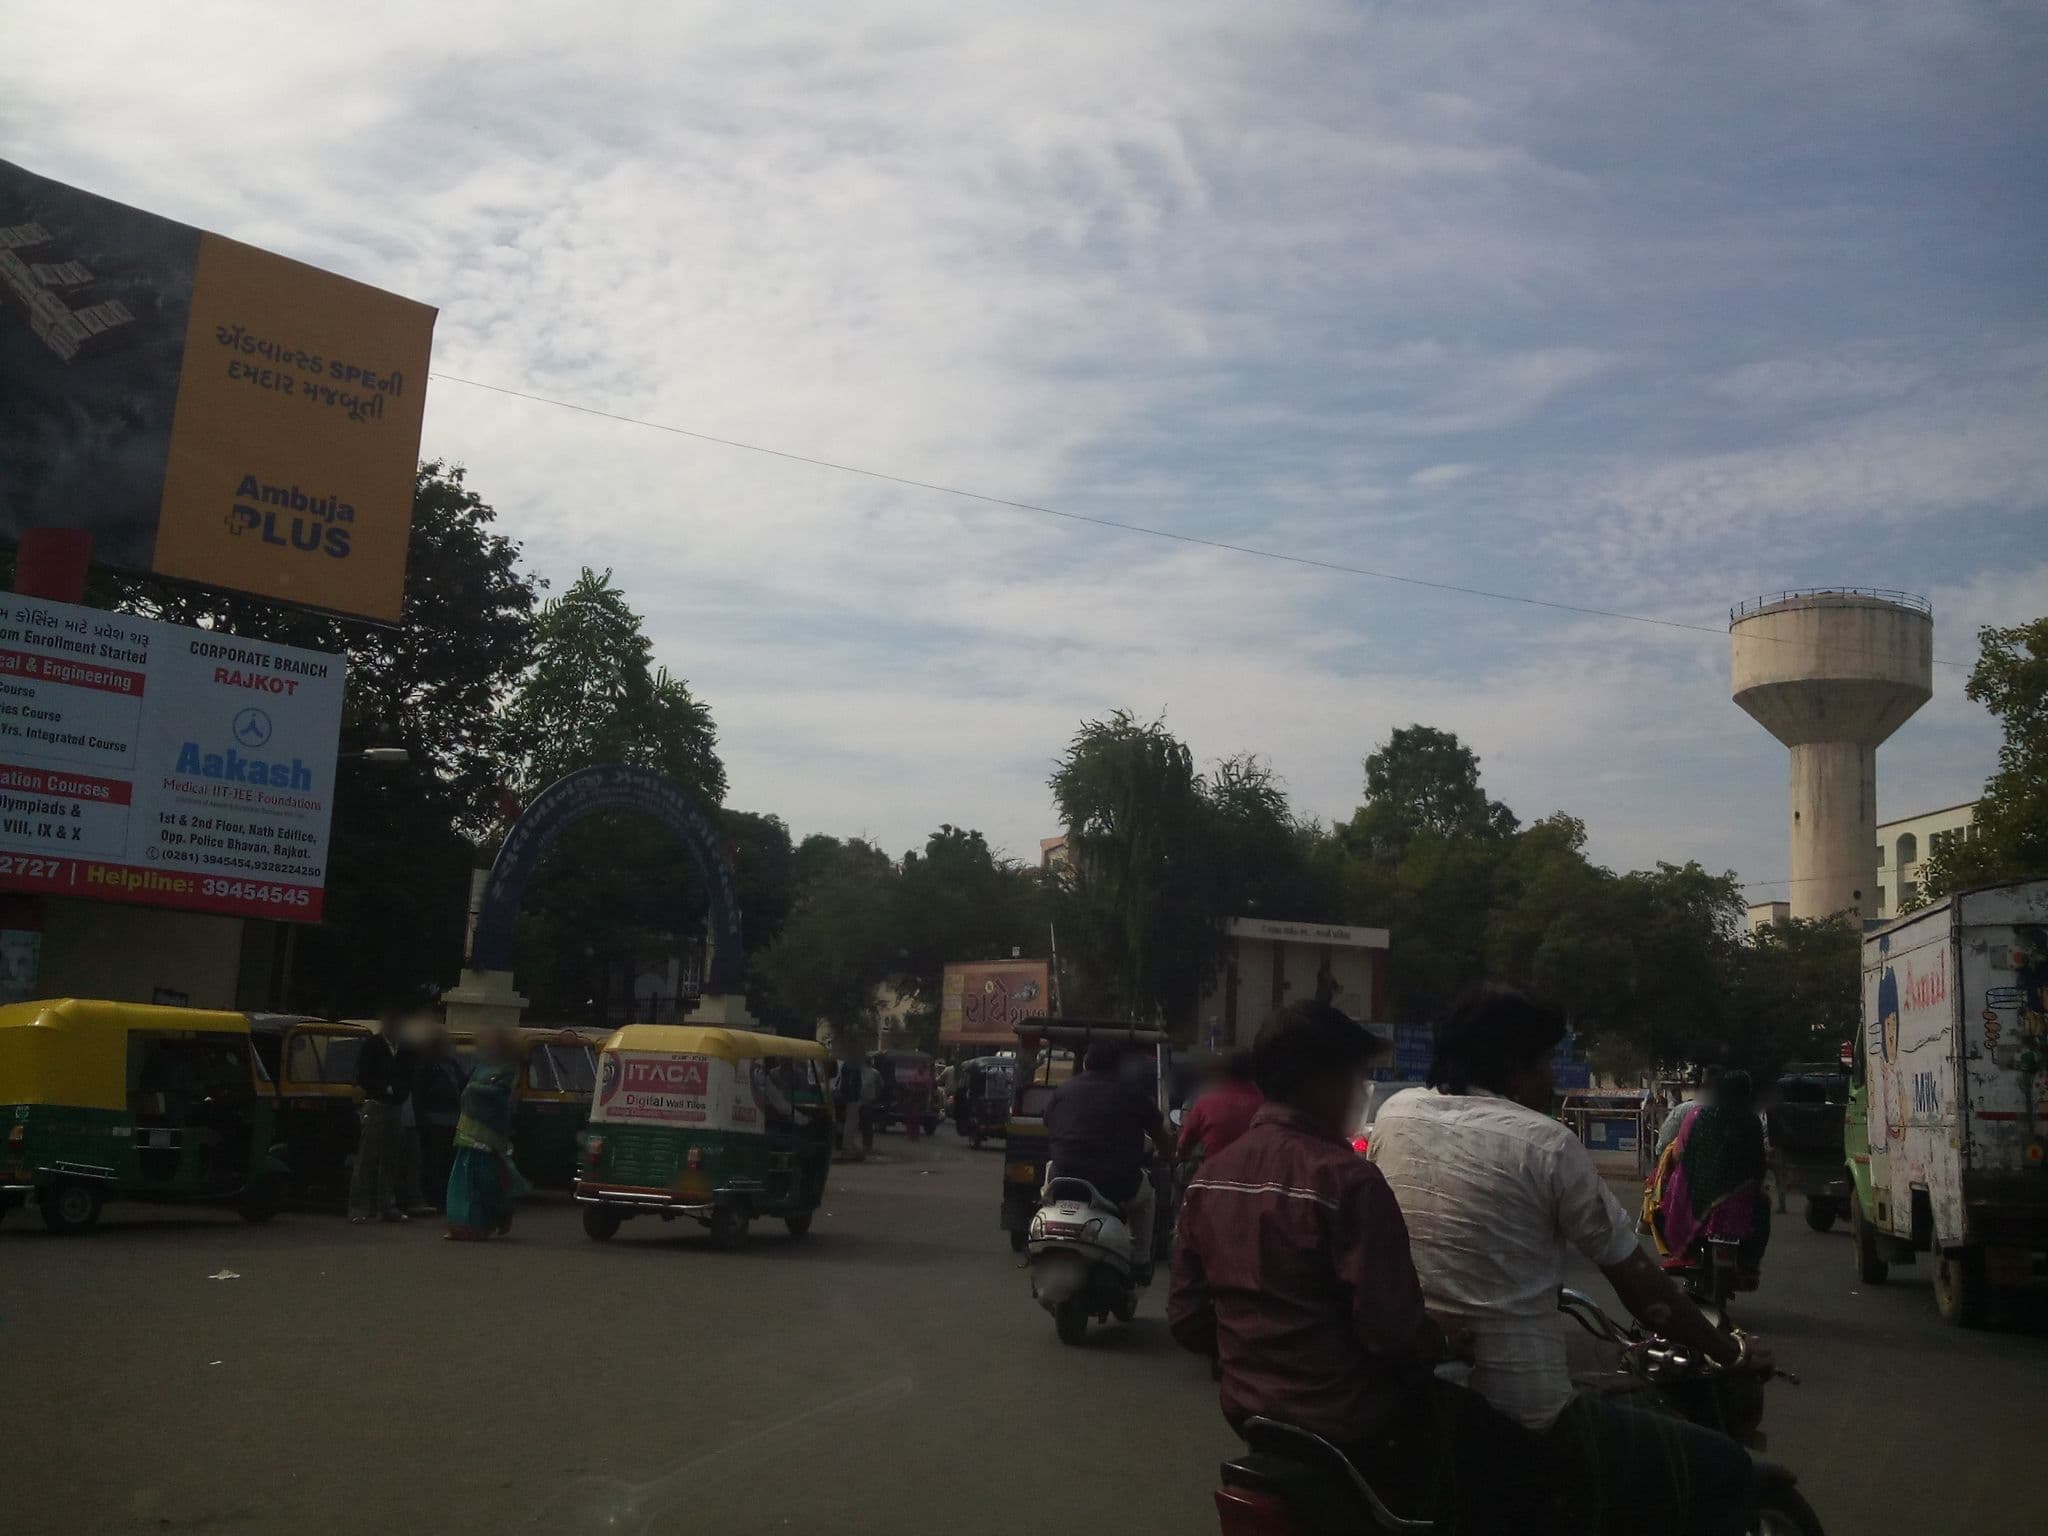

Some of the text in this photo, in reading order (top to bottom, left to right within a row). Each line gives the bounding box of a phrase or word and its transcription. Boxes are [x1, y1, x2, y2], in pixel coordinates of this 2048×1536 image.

[236, 474, 355, 523] Ambuja
[233, 503, 351, 558] PLUS
[24, 630, 96, 656] Enrollment
[100, 644, 147, 664] Started
[190, 641, 328, 678] CORPORATE BRANCH
[25, 658, 37, 673] &
[43, 661, 132, 692] Engineering
[214, 667, 298, 696] RAJKOT
[22, 706, 61, 722] Course
[26, 727, 85, 746] Integrated
[88, 736, 127, 752] Course
[176, 742, 312, 792] Aakash
[47, 776, 110, 798] Courses
[163, 778, 208, 796] Medical
[257, 791, 321, 810] Foundations
[71, 804, 81, 818] &
[38, 823, 51, 838] IX
[56, 826, 66, 839] &
[71, 827, 82, 841] X
[160, 811, 317, 845] 1st & 2nd Floor, Nath Edifice,
[161, 829, 186, 844] Opp.
[190, 834, 223, 848] Police
[274, 844, 311, 859] Rajkot.
[87, 864, 194, 893] Helpline:
[202, 878, 310, 906] 39454545
[1904, 947, 1946, 1011] Amul
[628, 1063, 702, 1082] ITACA
[626, 1094, 707, 1110] Digital Wall Tiles
[1914, 1071, 1938, 1113] Milk
